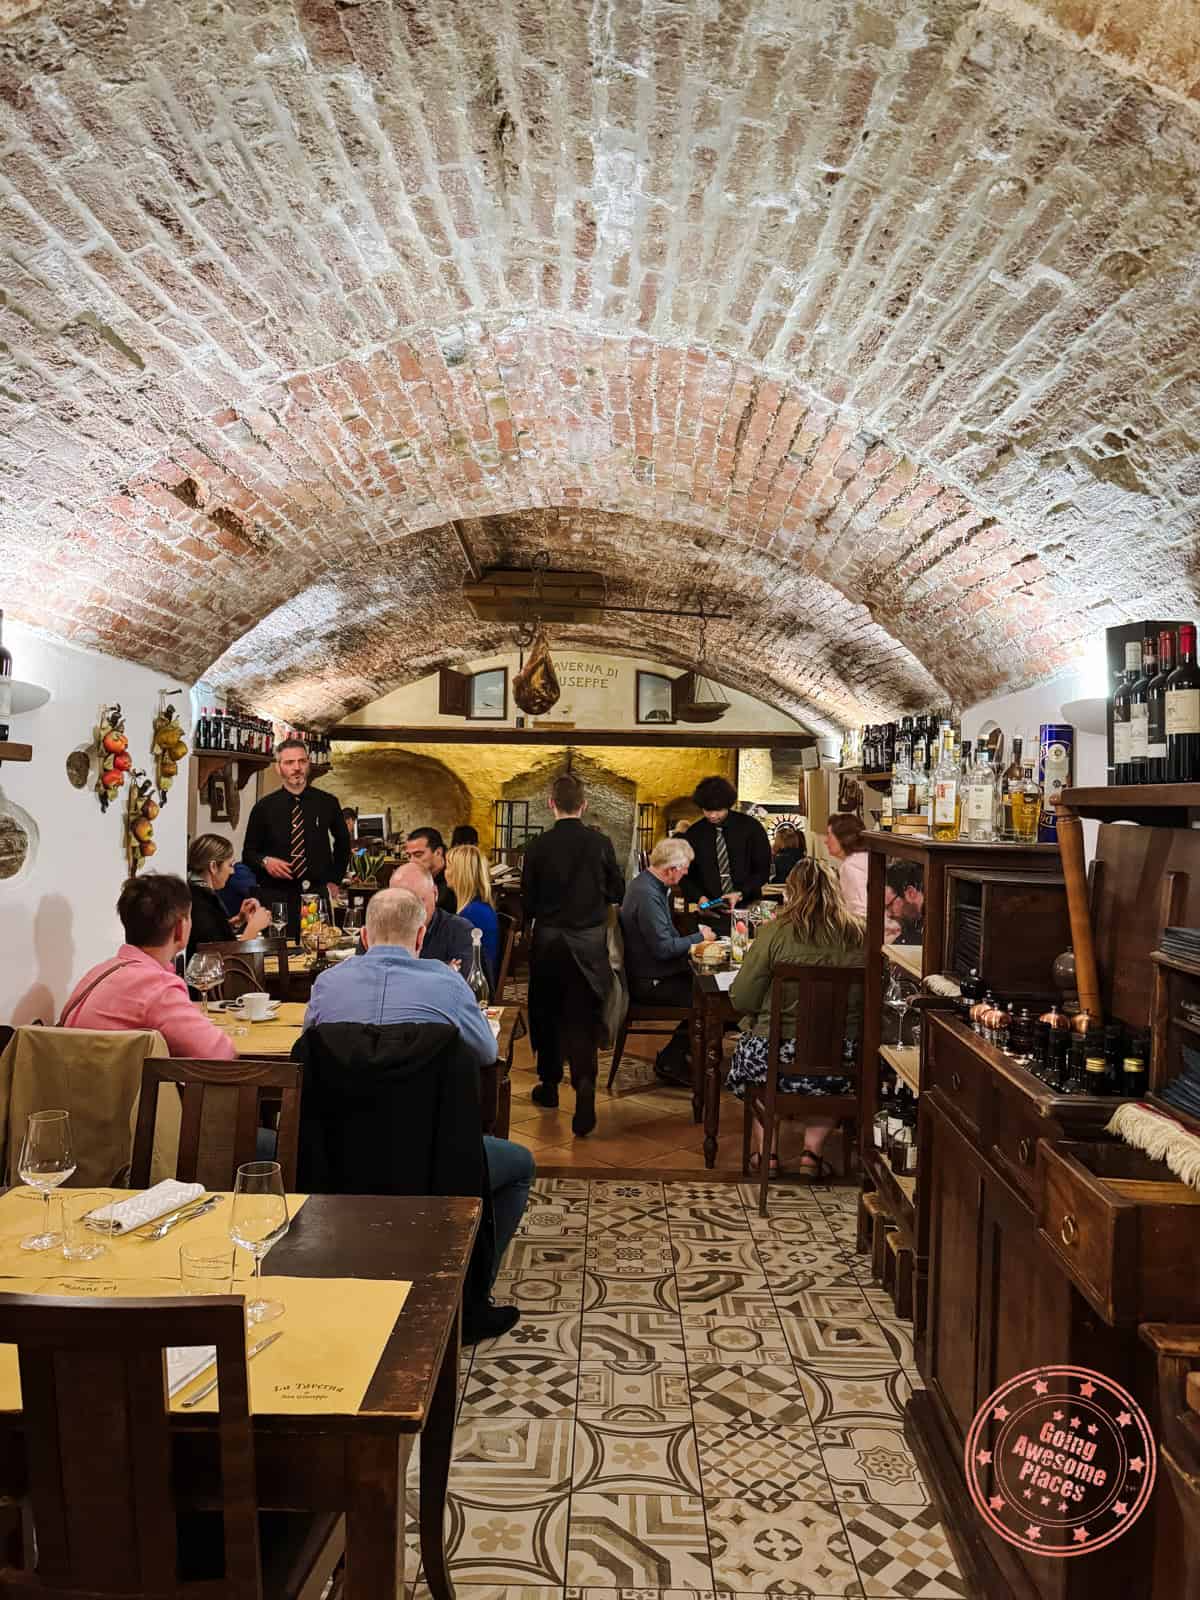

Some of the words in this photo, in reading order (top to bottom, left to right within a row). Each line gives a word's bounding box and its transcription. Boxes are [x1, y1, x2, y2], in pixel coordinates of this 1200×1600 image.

[554, 662, 603, 674] AVERNA
[607, 668, 618, 678] DI
[560, 677, 608, 688] USEPPE
